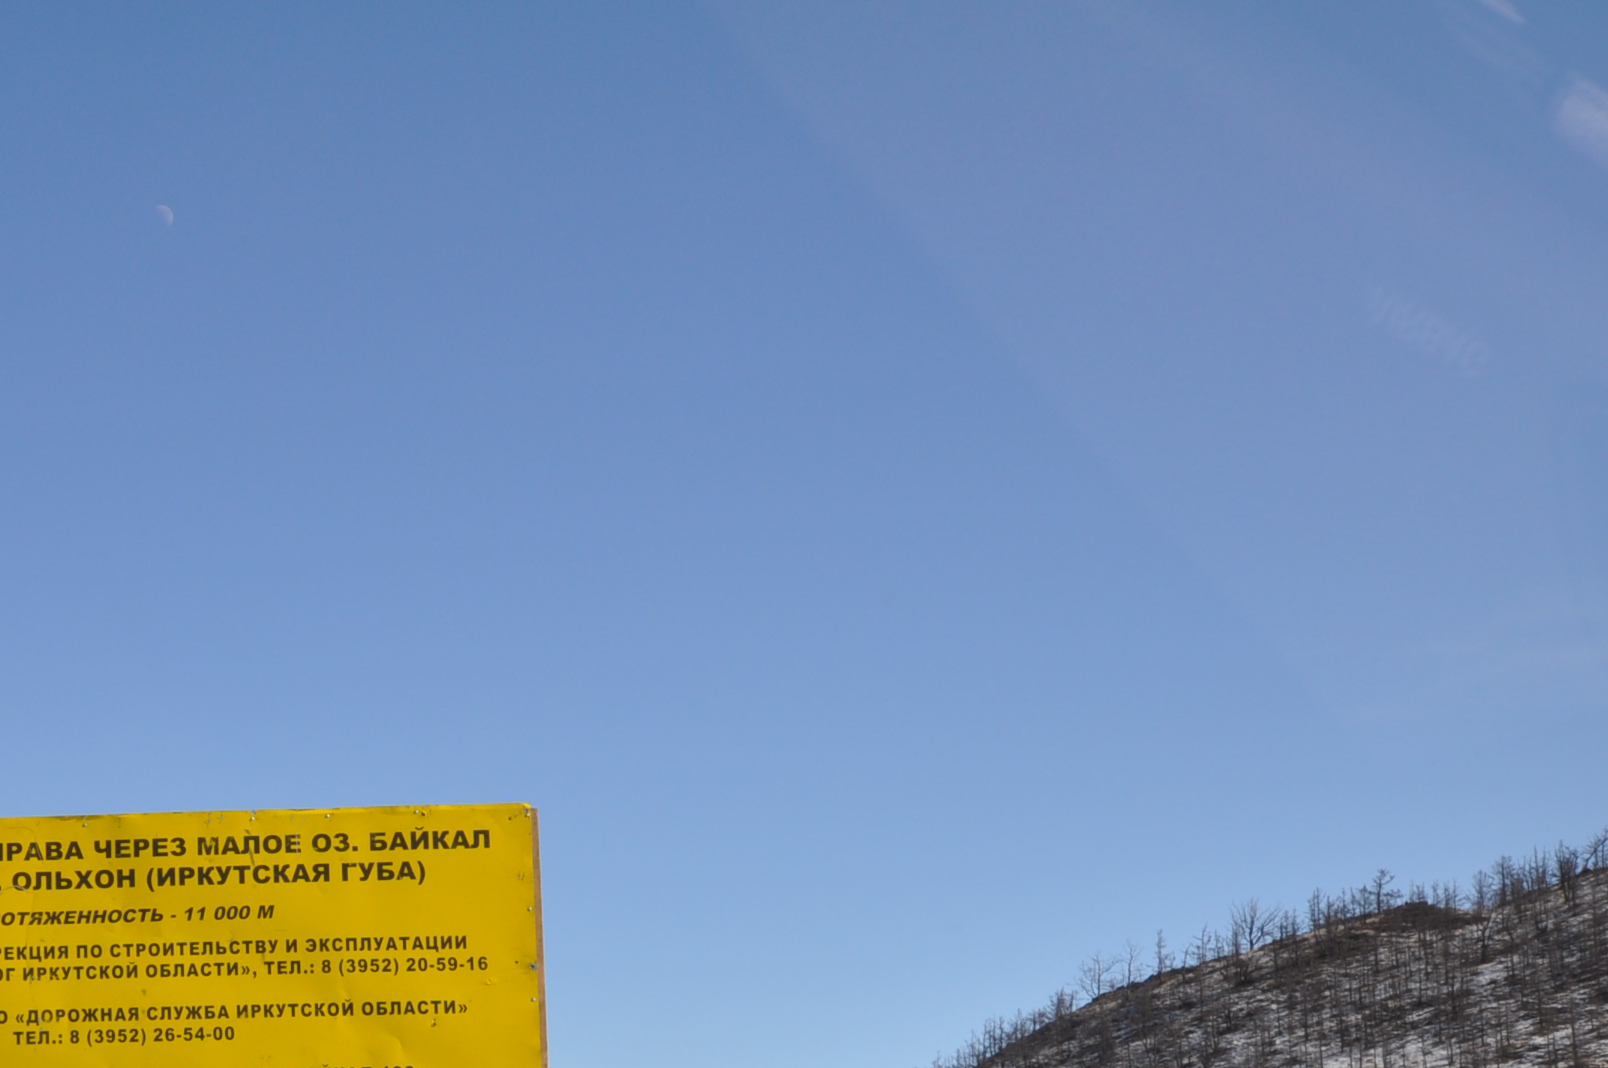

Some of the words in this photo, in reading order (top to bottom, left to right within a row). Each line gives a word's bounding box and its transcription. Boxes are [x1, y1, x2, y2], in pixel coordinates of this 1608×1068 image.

[93, 837, 187, 859] ЧЕРЕЗ
[197, 834, 302, 856] МАЛОЕ
[311, 832, 358, 853] ОЗ.
[369, 827, 490, 852] БАЙКАЛ
[12, 868, 136, 892] ОЛЬХОН
[146, 863, 330, 893] (ИРКУТСКАЯ
[341, 860, 426, 885] ГУБА)
[184, 906, 206, 921] 11
[213, 905, 251, 921] 000
[257, 905, 275, 919] М
[76, 944, 103, 959] ПО
[109, 939, 278, 958] СТРОИТЕЛЬСТВУ
[285, 938, 298, 953] И
[305, 935, 467, 953] ЭКСПЛУАТАЦИИ
[22, 961, 138, 981] ИРКУТСКОЙ
[145, 962, 257, 978] ОБЛАСТИ»,
[263, 960, 314, 975] ТЕЛ.:
[321, 959, 332, 974] 8
[338, 958, 399, 977] (3952)
[406, 956, 488, 972] 20-59-16
[15, 1007, 139, 1026] «ДОРОЖНАЯ
[146, 1005, 230, 1021] СЛУЖБА
[236, 1002, 354, 1019] ИРКУТСКОЙ
[361, 1000, 468, 1016] ОБЛАСТИ»
[12, 1030, 63, 1045] ТЕЛ.:
[70, 1029, 80, 1044] 8
[86, 1028, 146, 1047] (3952)
[153, 1026, 235, 1042] 26-54-00
